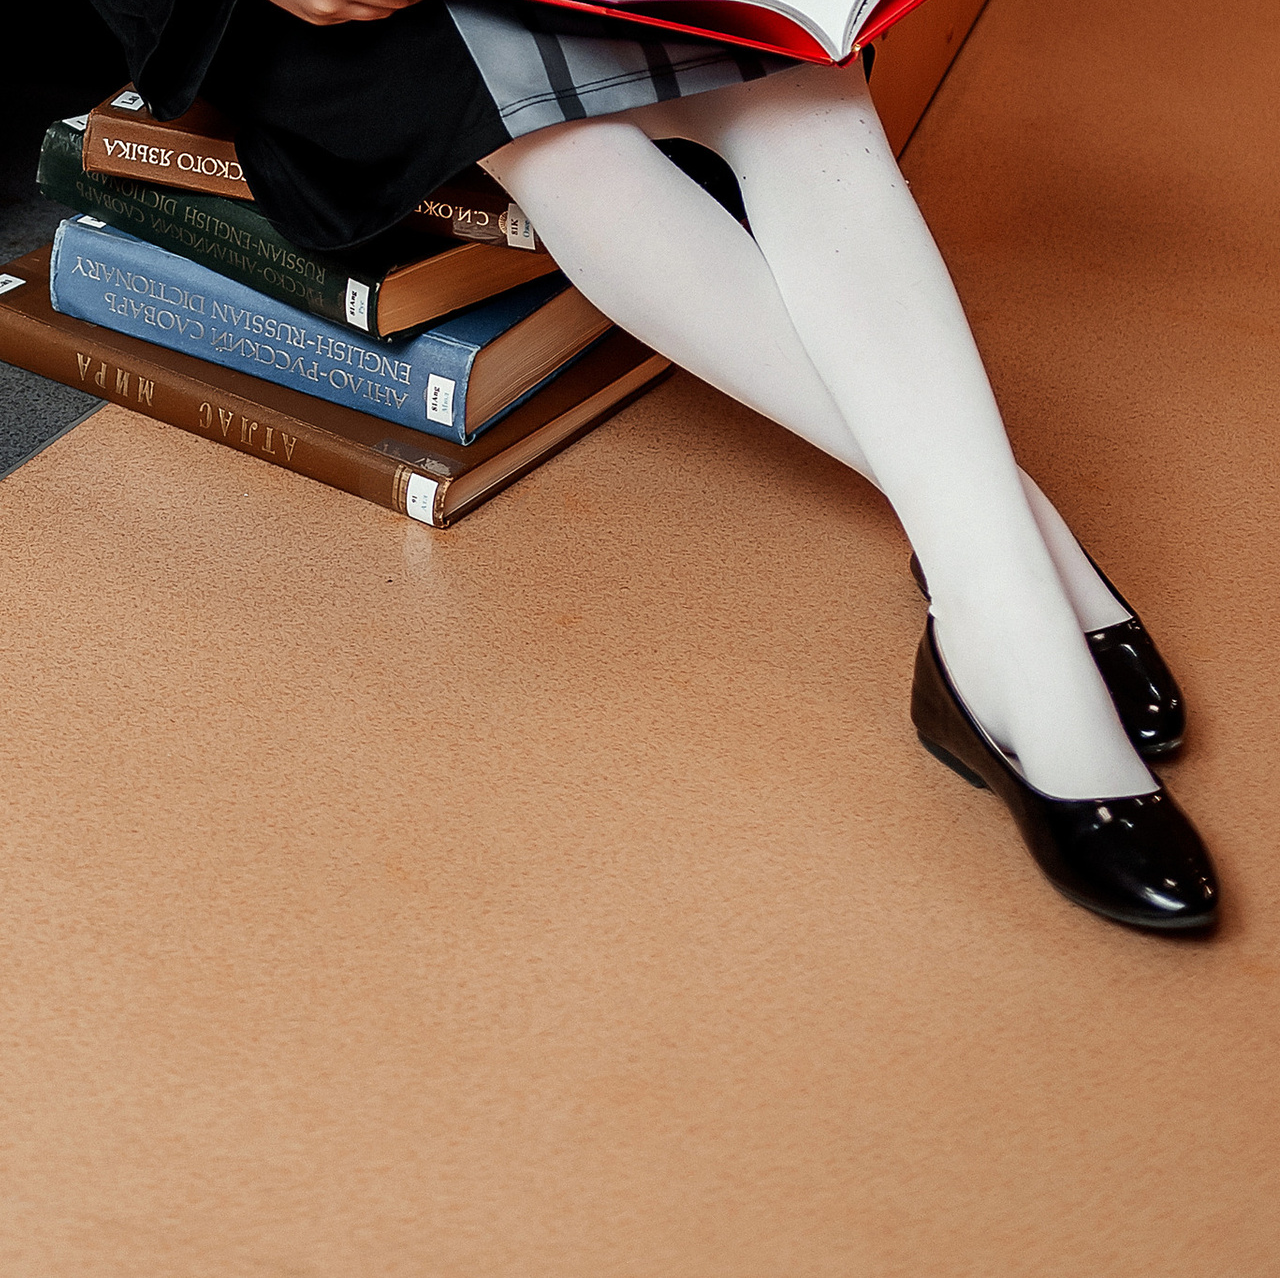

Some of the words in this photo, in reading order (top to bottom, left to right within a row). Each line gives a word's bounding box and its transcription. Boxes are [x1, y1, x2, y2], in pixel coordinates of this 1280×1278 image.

[99, 136, 174, 167] ЯЗЫКА
[70, 178, 148, 226] СЛОВАРЬ
[180, 204, 330, 284] RUSSIAN-ENGLISH
[69, 253, 209, 316] DICTIONARY
[99, 289, 207, 341] СЛОВАРЬ
[206, 326, 409, 412] АНГЛО-РУССКИЙ
[207, 299, 415, 384] ENGLISH-RUSSIAN
[67, 350, 161, 409] МИРА
[192, 399, 299, 462] АТЛАС
